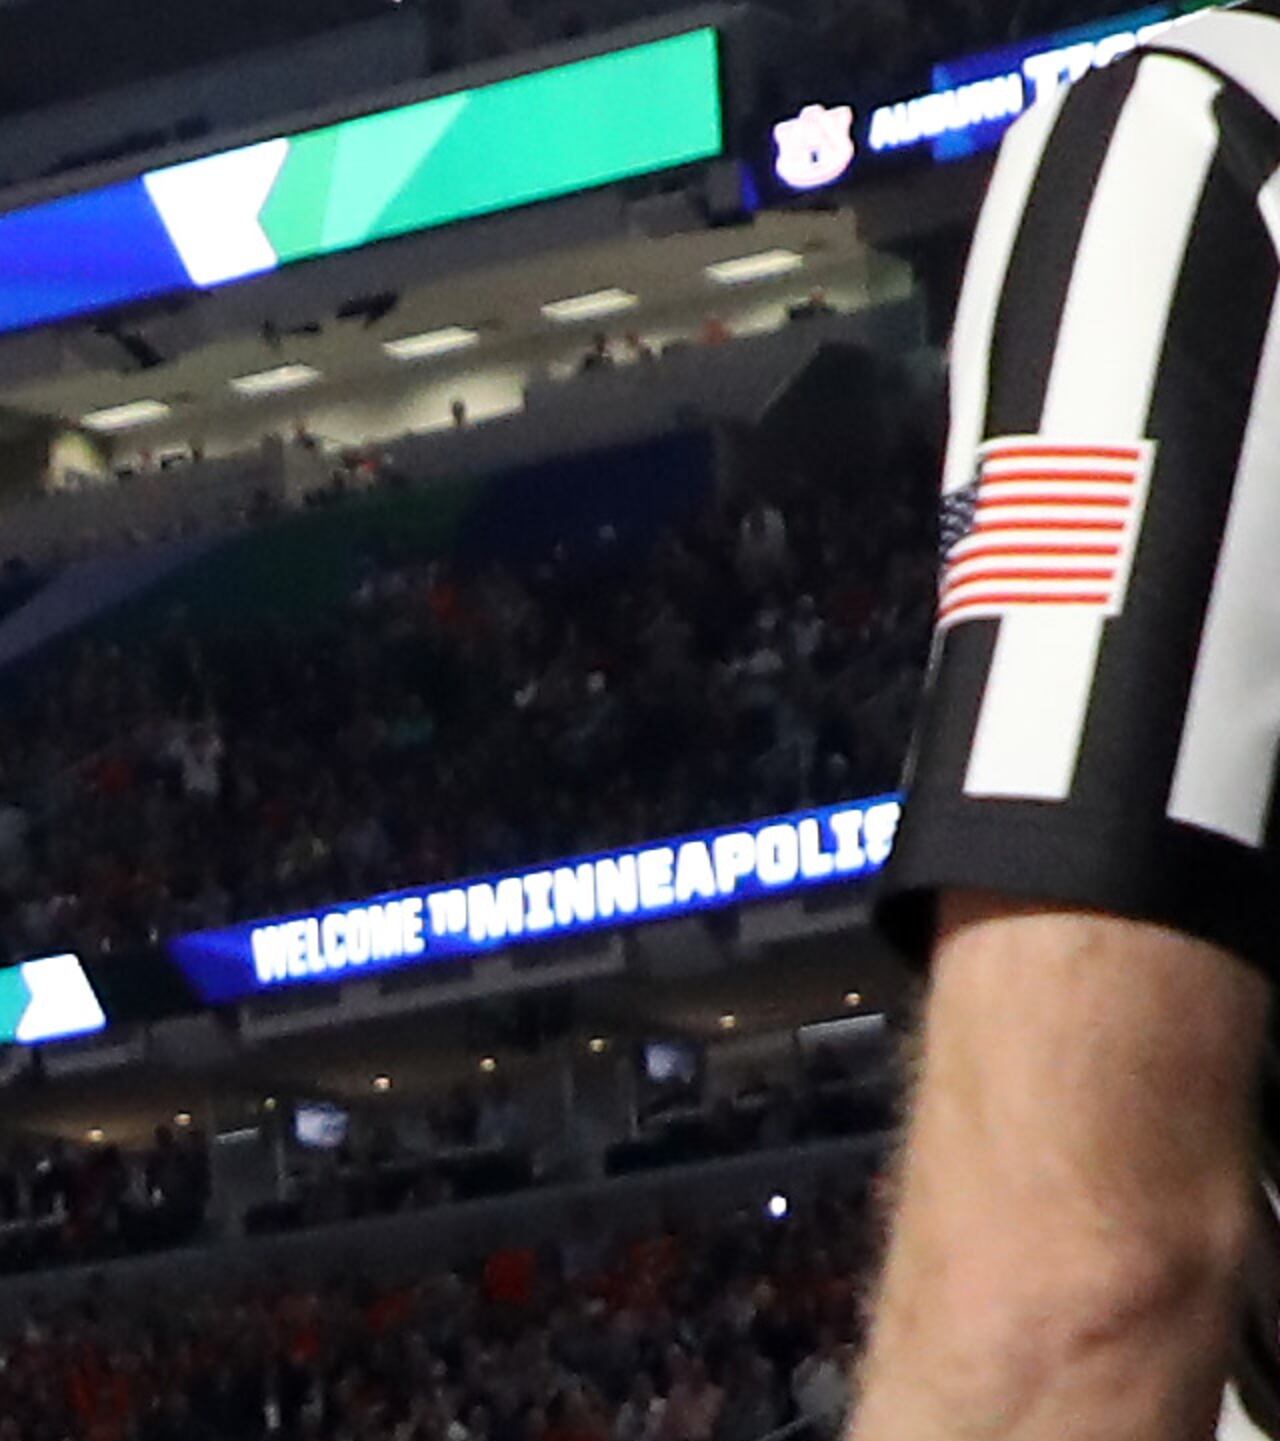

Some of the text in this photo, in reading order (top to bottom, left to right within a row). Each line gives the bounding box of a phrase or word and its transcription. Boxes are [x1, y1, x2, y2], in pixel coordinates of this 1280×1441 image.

[251, 801, 902, 984] WELCOME TO MINNEAPOLIS
